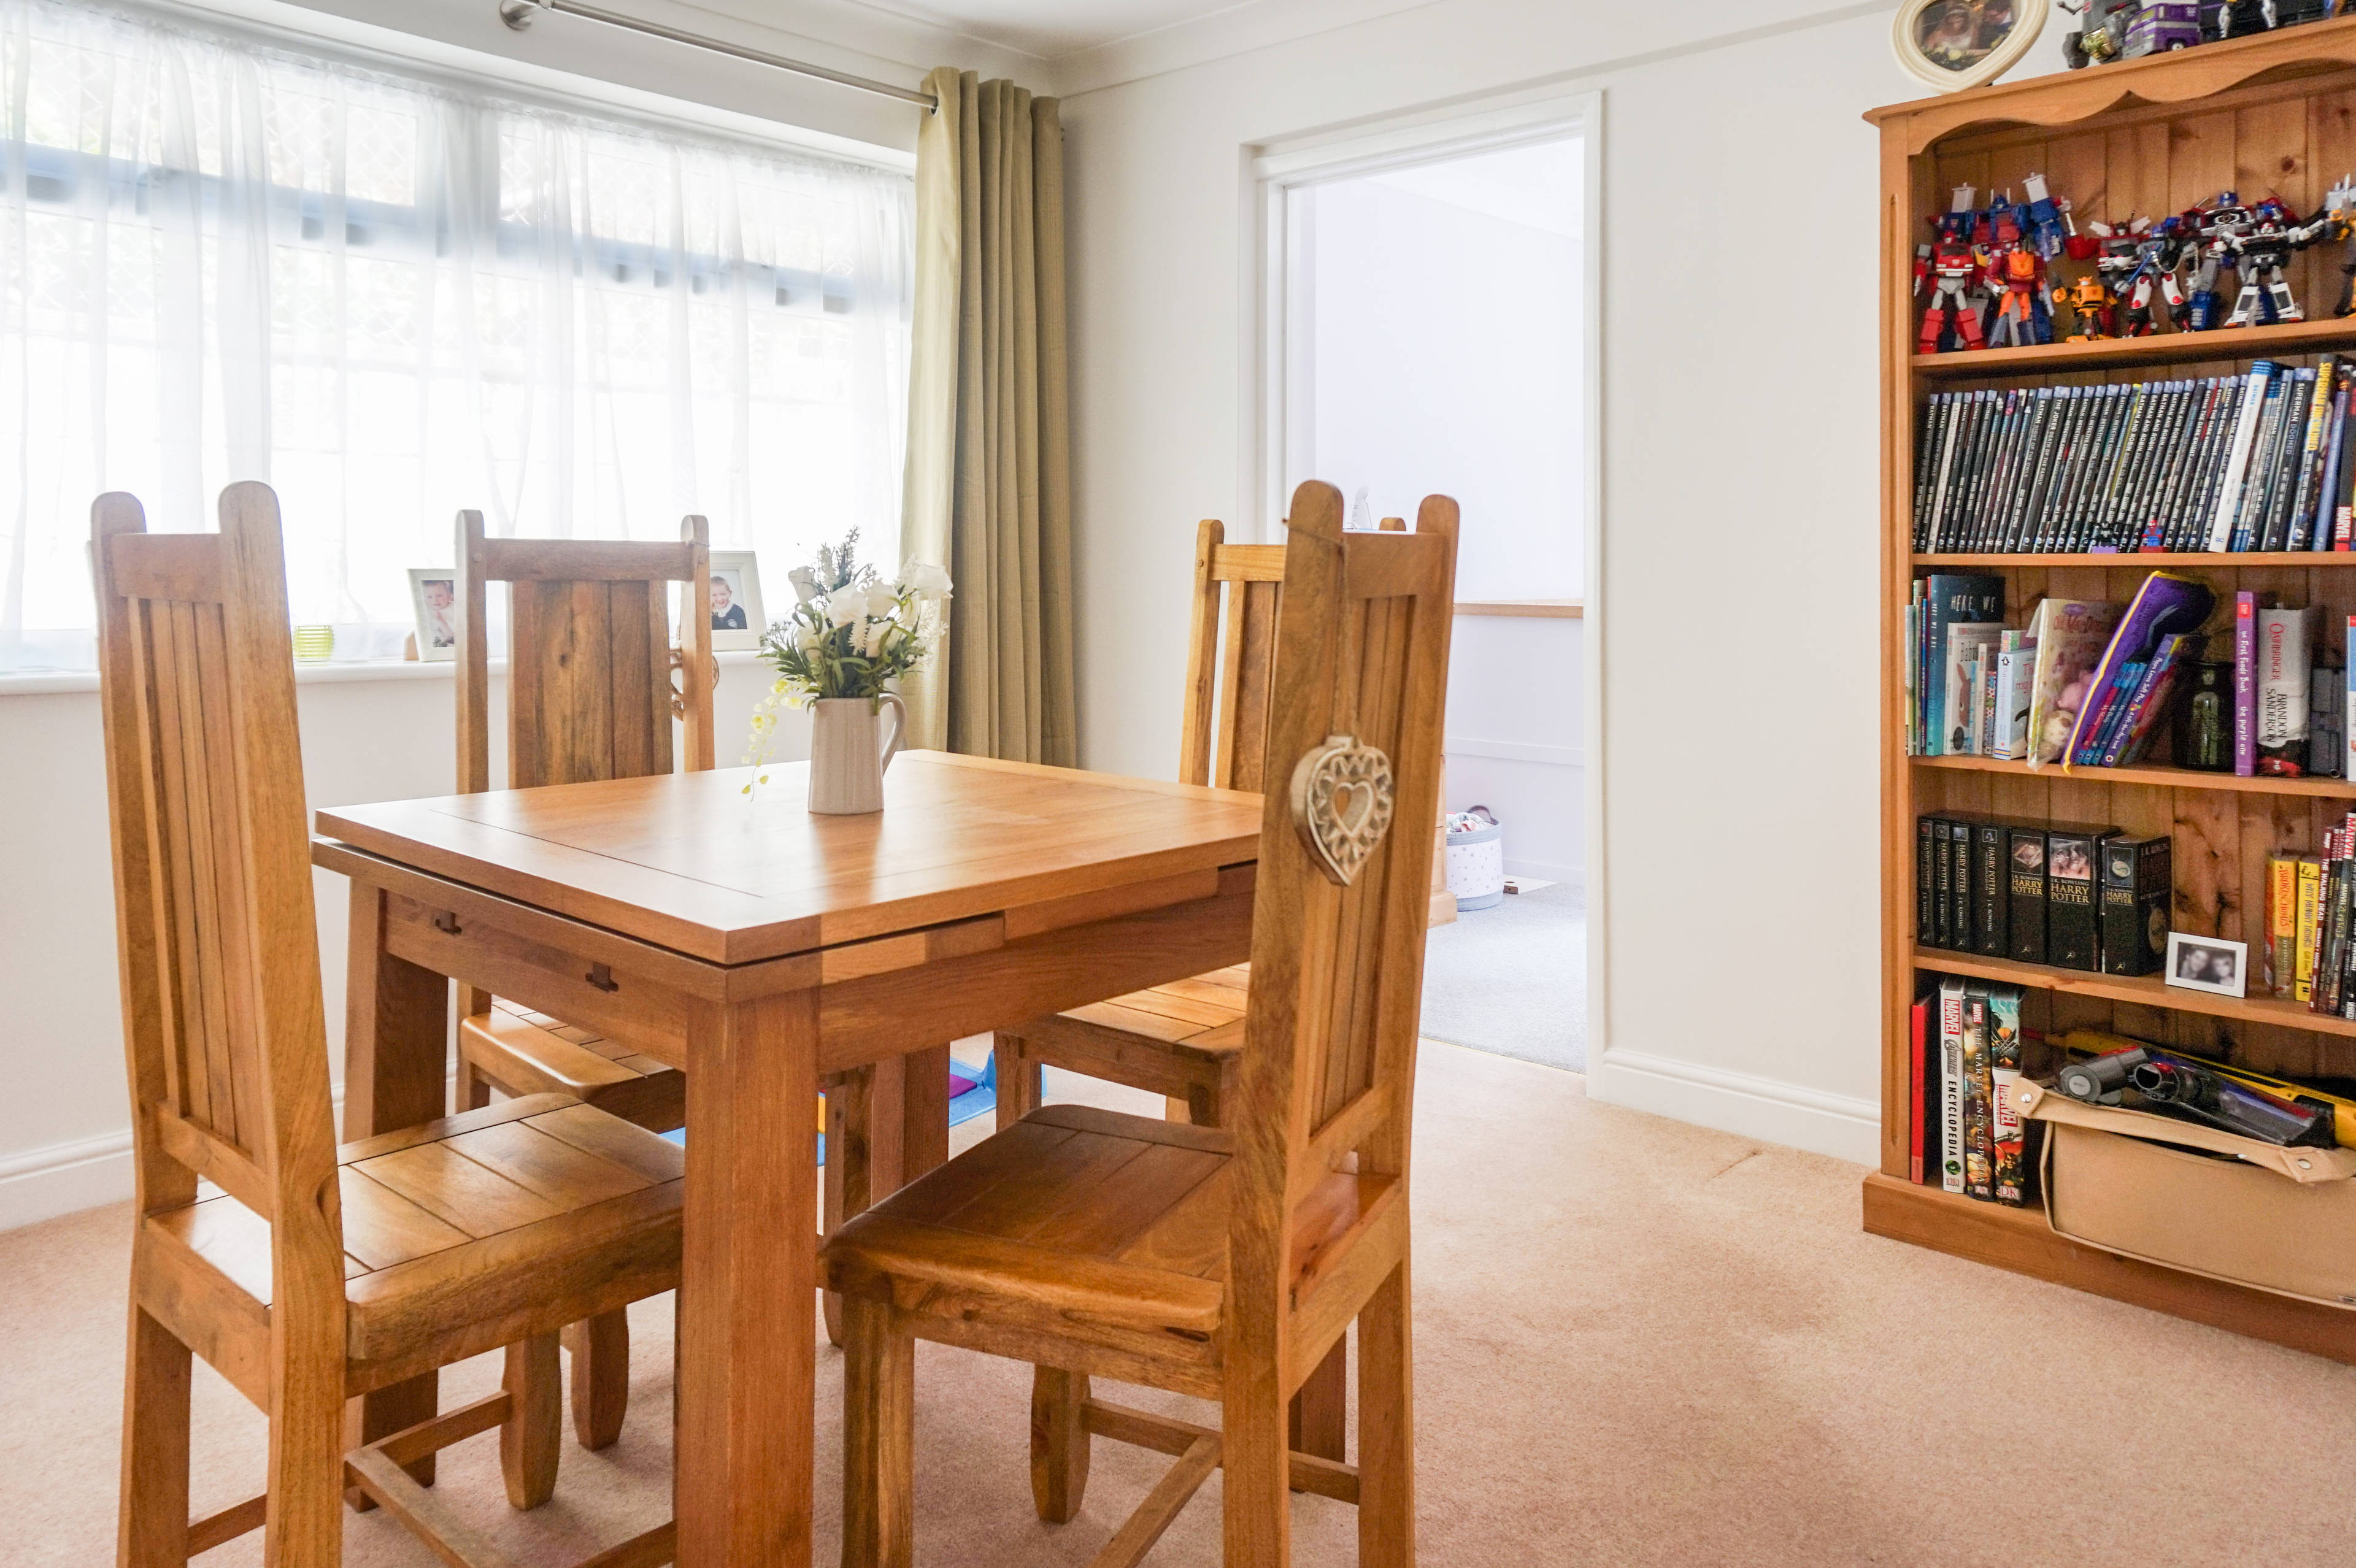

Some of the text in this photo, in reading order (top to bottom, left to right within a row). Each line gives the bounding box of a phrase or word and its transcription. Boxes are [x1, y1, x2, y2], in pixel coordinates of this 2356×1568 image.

[2201, 390, 2211, 409] BATMAN
[2212, 389, 2222, 407] BATMAN
[2223, 388, 2233, 407] BATMAN
[2236, 386, 2245, 405] BATMAN
[2249, 385, 2259, 405] BATMAN
[2035, 399, 2046, 423] BATMAN
[2067, 398, 2076, 417] BATMAN
[2079, 398, 2088, 417] BATMAN
[2091, 398, 2100, 415] BATMAN
[2103, 397, 2112, 415] BATMAN
[2117, 396, 2125, 414] BATMAN
[2135, 394, 2146, 418] BATMAN
[2307, 362, 2330, 450] SUPERMAN UNCHAINED
[2050, 412, 2059, 429] JOKER
[2131, 420, 2139, 432] AND
[2136, 394, 2158, 451] BATMAN AND ROBIN
[2146, 393, 2168, 451] BATMAN AND ROBIN
[2158, 393, 2178, 445] BATMAN AND ROBIN
[2170, 392, 2190, 444] BATMAN AND ROBIN
[2205, 420, 2214, 435] DARK
[2216, 420, 2225, 434] DARK
[2229, 419, 2238, 434] DARK
[2286, 383, 2304, 455] SUPERMAN DOOMED
[2031, 425, 2040, 440] NIGHT
[2060, 420, 2071, 443] DETECTIVE
[2073, 420, 2083, 443] DETECTIVE
[2084, 419, 2094, 442] DETECTIVE
[2096, 418, 2106, 442] DETECTIVE
[2109, 419, 2119, 442] DETECTIVE
[2194, 421, 2203, 436] DARK
[2046, 431, 2055, 447] DEATH
[2125, 433, 2136, 451] ROBIN
[2189, 437, 2199, 456] KNIGHT
[2200, 436, 2210, 455] KNIGHT
[2211, 435, 2221, 455] KNIGHT
[2224, 435, 2233, 454] KNIGHT
[2023, 462, 2032, 477] OWLS
[2036, 467, 2046, 485] FAMILY
[2335, 507, 2352, 539] MARVEL
[1951, 595, 1995, 612] HERE WE
[2241, 639, 2249, 655] First
[2269, 623, 2285, 680] OATHBRINGER
[2135, 657, 2163, 703] Peppa Loves Soft Play
[2241, 705, 2249, 717] the
[2266, 688, 2276, 742] SANDERSON
[2277, 694, 2287, 738] BRANDON
[2239, 719, 2249, 742] purple
[2344, 817, 2356, 859] MARVEL
[2321, 858, 2330, 870] THE
[2012, 878, 2042, 889] HARRY
[2012, 885, 2043, 896] POTTER
[2051, 883, 2090, 895] HARRY
[2319, 873, 2328, 901] WALKING
[2050, 892, 2090, 904] POTTER
[2106, 891, 2133, 899] HARRY
[2279, 869, 2290, 928] BROKEN HOMES
[2339, 883, 2348, 905] MARVEL
[2303, 883, 2315, 948] WHY MUMMY DRINKS
[2317, 902, 2326, 921] DEAD
[1945, 999, 1960, 1034] MARVEL
[1973, 1003, 1982, 1024] MARVEL
[1974, 1026, 1982, 1047] THE
[1948, 1080, 1957, 1156] ENCYCLOPEDIA
[1976, 1100, 1985, 1182] ENCYCLOPEDIA
[2001, 1186, 2017, 1197] DK
